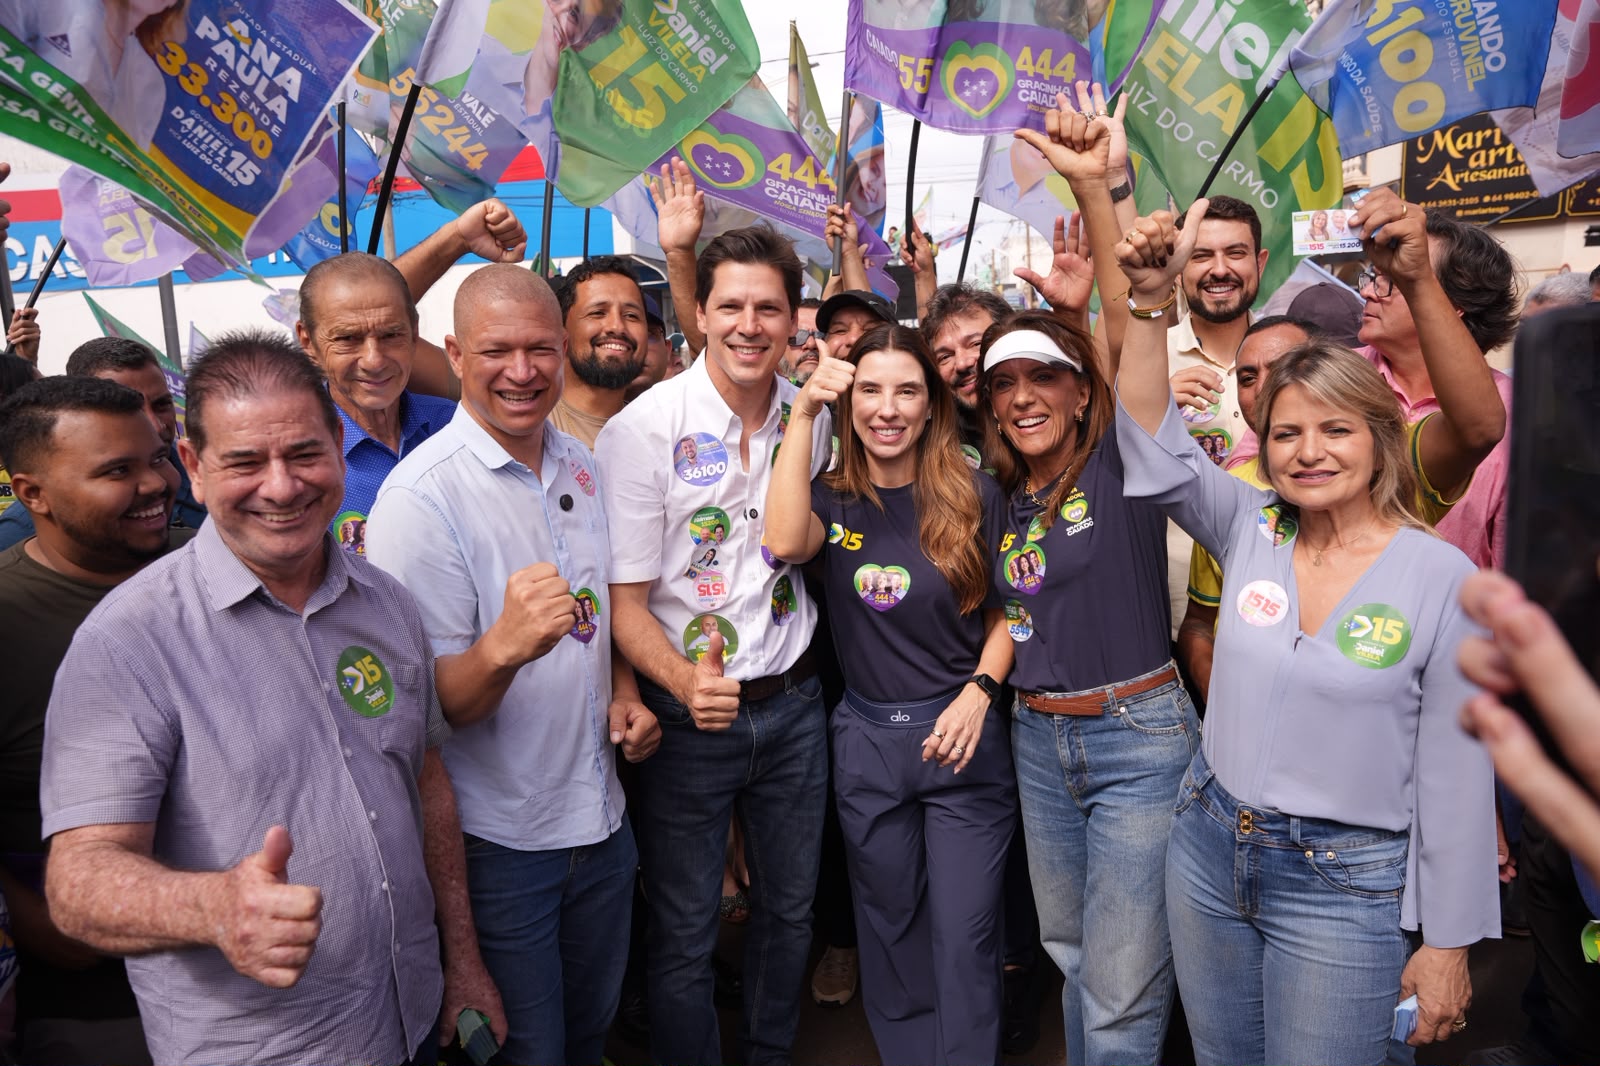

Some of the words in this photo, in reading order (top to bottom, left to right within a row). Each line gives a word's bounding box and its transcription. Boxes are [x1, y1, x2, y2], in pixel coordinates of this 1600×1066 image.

[270, 36, 318, 75] ESTADUAL
[648, 8, 706, 83] VILELA
[866, 29, 899, 68] CAIADO
[1441, 20, 1466, 82] ESTADUAL
[1449, 0, 1486, 92] RUVINEL
[1470, 0, 1507, 72] ANDO
[195, 16, 289, 124] PAULA
[222, 19, 302, 103] ANA
[588, 24, 687, 129] 15
[638, 24, 658, 48] LUIZ
[655, 46, 670, 62] DO
[667, 61, 699, 94] CARMO
[899, 54, 935, 94] 55
[1015, 46, 1077, 84] 444
[156, 41, 273, 159] 33.300
[205, 57, 282, 137] REZENDE
[1017, 79, 1072, 97] GRACINHA
[1155, 107, 1194, 142] DO
[1360, 85, 1382, 133] SAÚDE
[171, 106, 230, 158] DANIEL
[180, 126, 224, 164] VILELA
[182, 138, 201, 156] LUIZ
[199, 154, 212, 165] DO
[212, 163, 238, 187] CARMO
[225, 150, 262, 186] 15
[684, 461, 726, 481] 36100
[841, 528, 864, 551] 15
[1000, 533, 1017, 551] 15
[1245, 590, 1281, 617] 1515
[1372, 616, 1404, 645] 15
[354, 655, 382, 686] 15
[890, 710, 910, 722] alo
